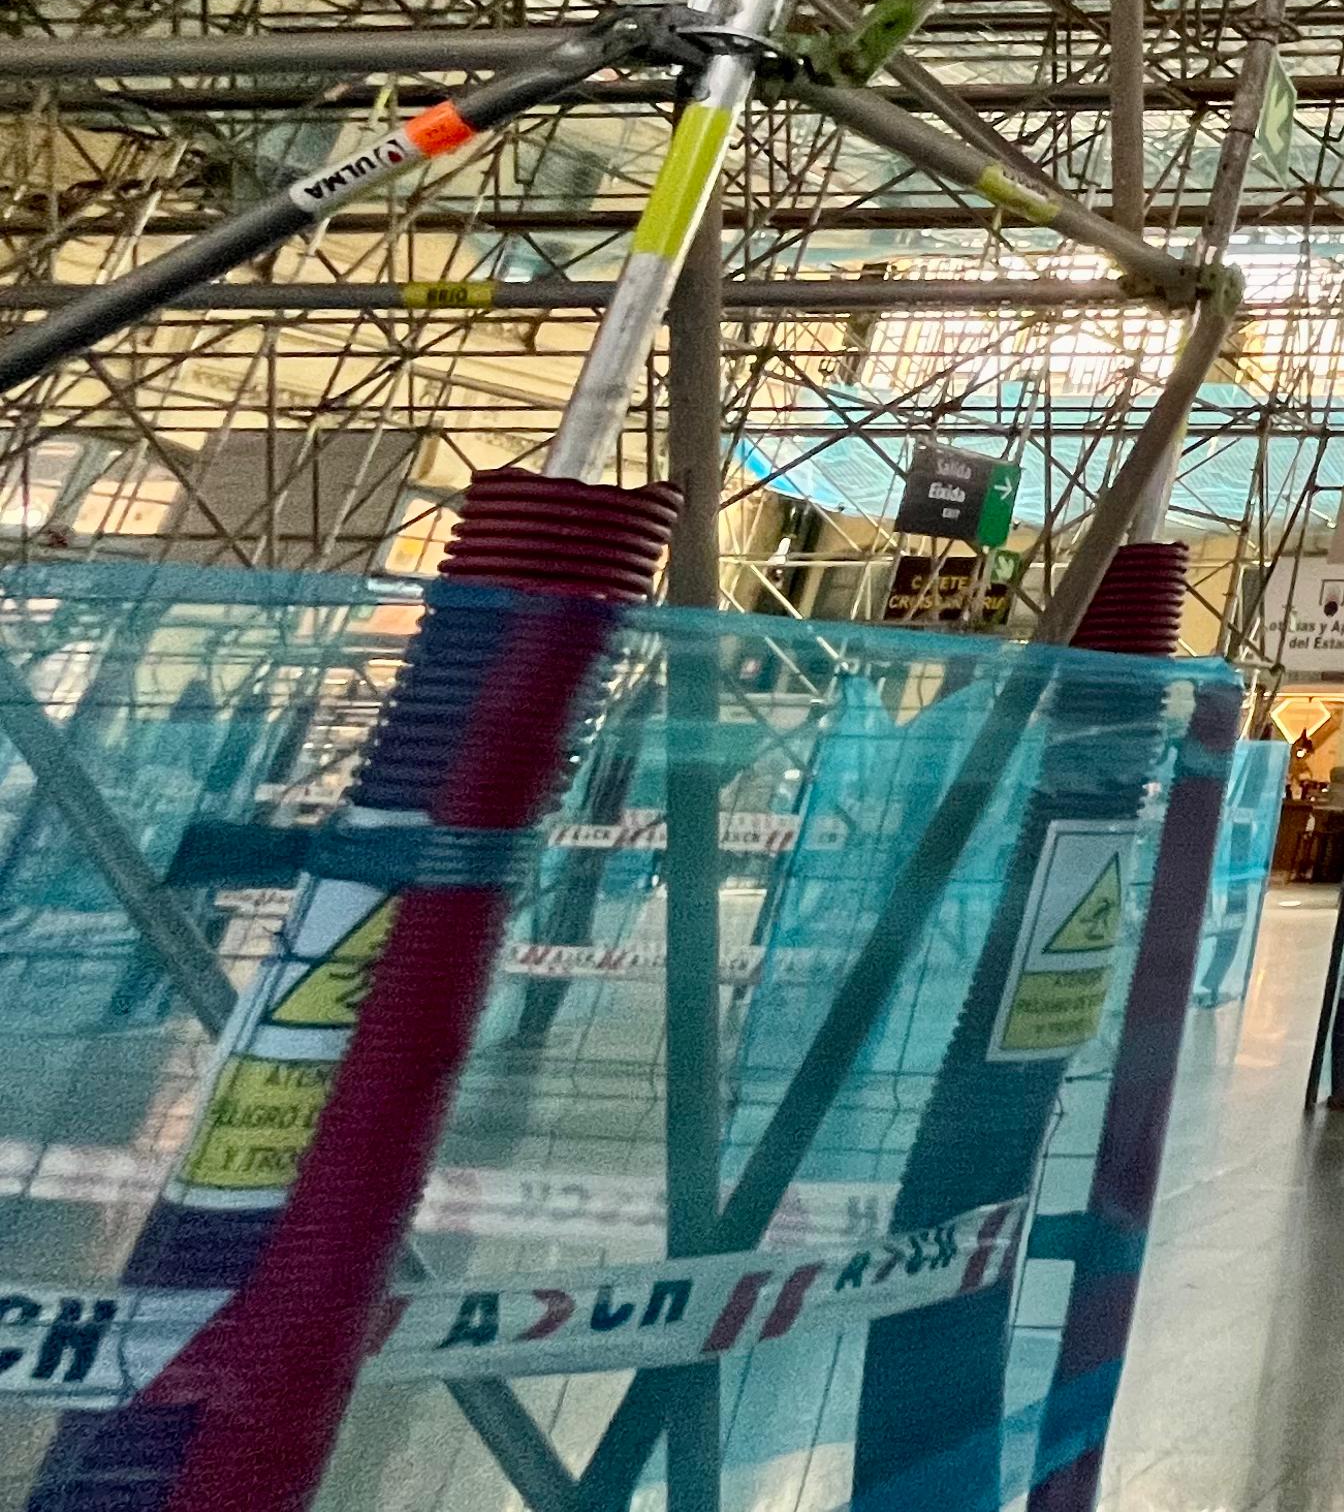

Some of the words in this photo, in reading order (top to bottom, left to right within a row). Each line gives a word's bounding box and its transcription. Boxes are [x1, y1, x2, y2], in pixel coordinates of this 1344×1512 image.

[304, 156, 377, 200] ULMA
[936, 457, 972, 481] Salida
[1319, 621, 1327, 635] y
[1289, 636, 1309, 650] del
